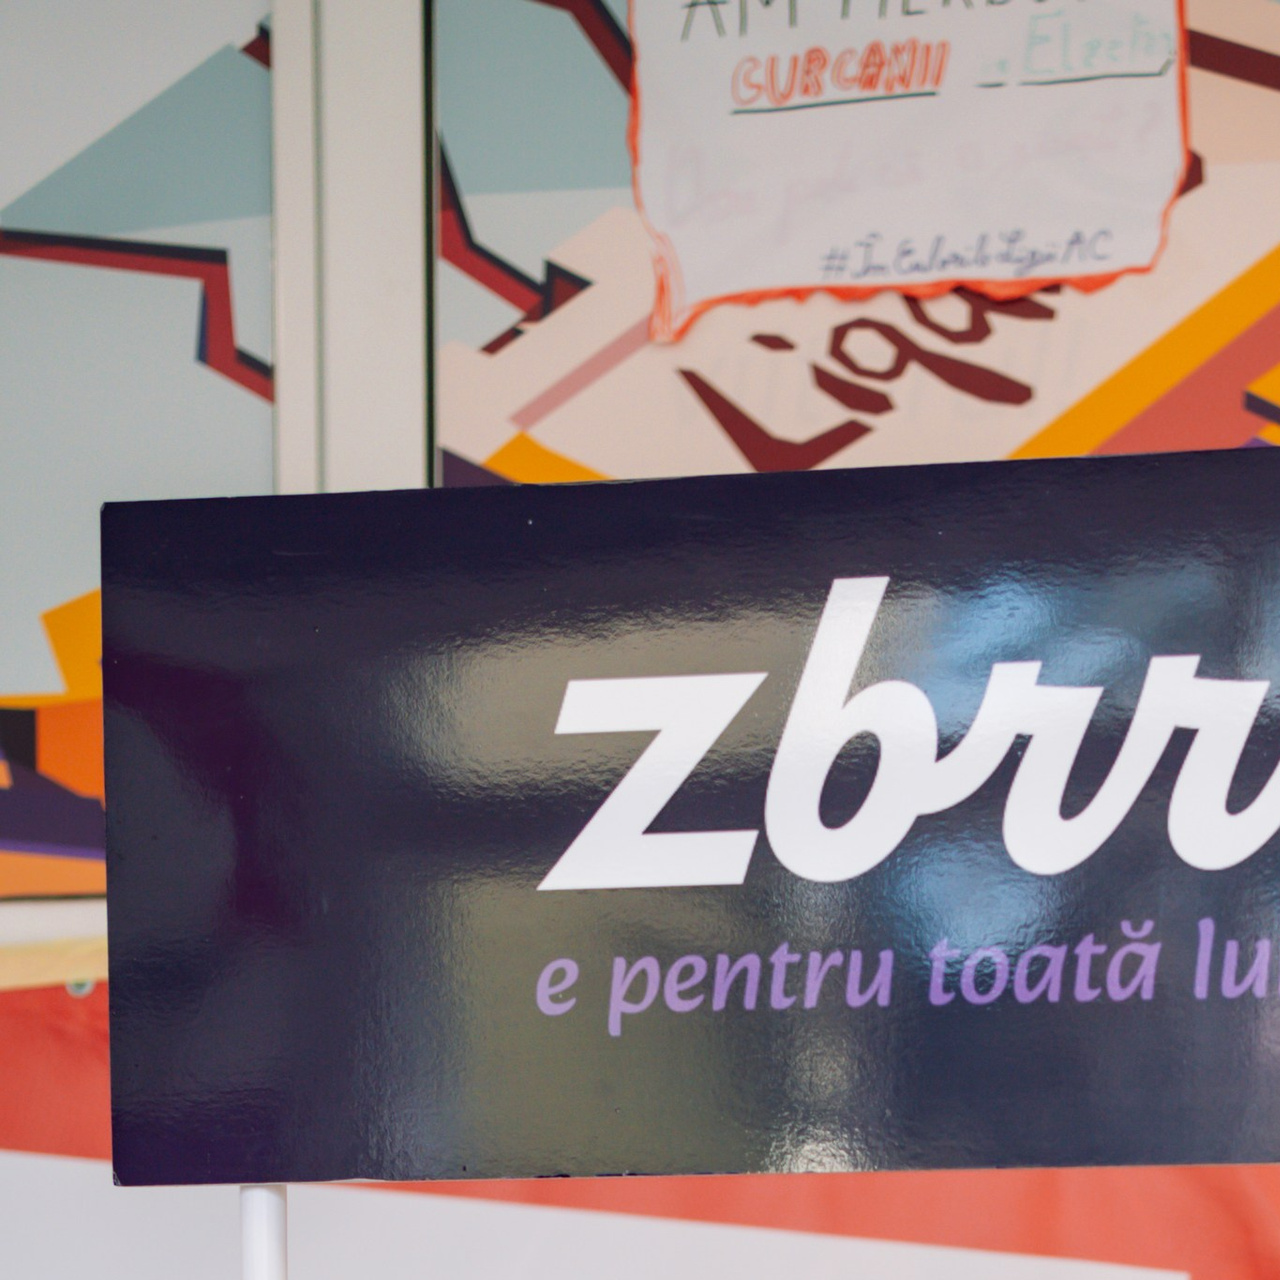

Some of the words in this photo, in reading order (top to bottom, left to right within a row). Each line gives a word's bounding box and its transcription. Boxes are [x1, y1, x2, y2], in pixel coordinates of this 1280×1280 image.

[536, 958, 580, 1016] e
[607, 941, 894, 1037] pentru
[928, 919, 1163, 1006] toată
